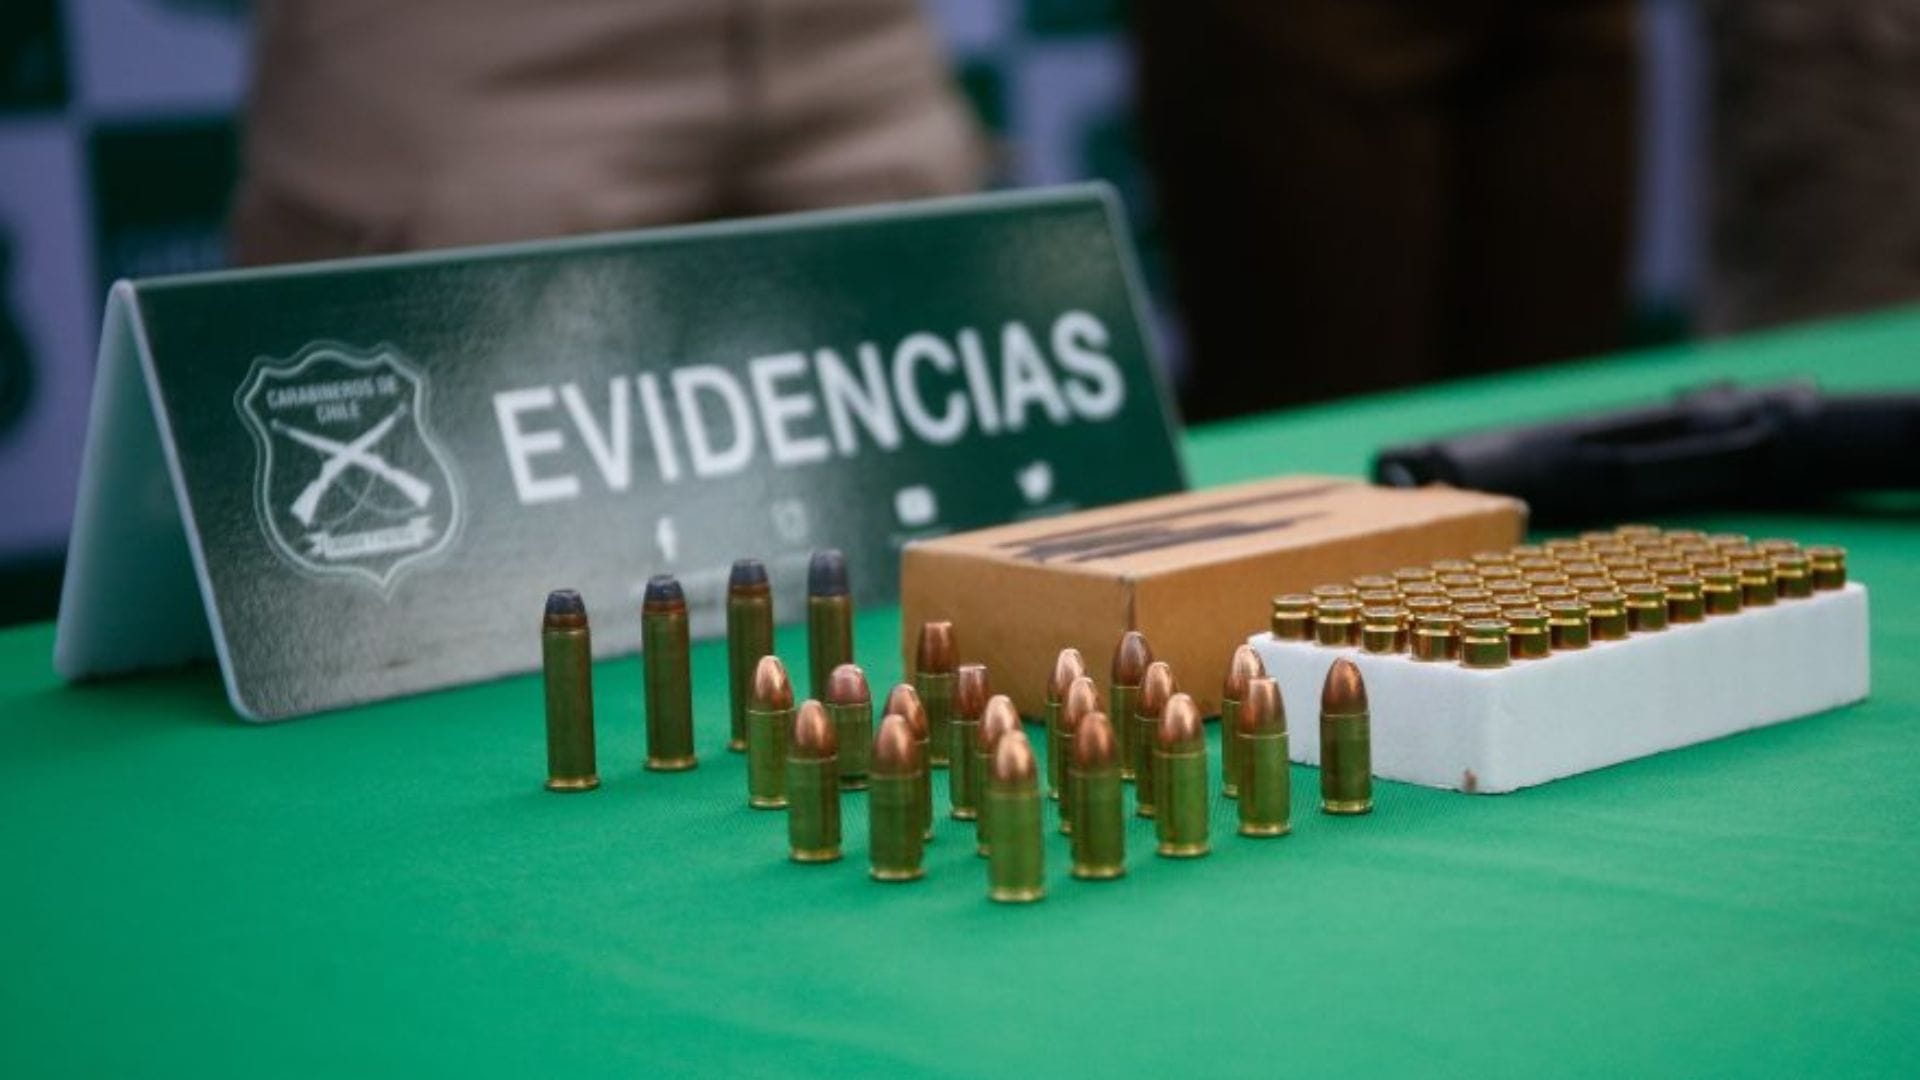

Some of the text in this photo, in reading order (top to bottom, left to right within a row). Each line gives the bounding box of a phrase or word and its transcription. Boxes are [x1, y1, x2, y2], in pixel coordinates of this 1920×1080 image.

[266, 374, 397, 409] CARABINEROS DE
[493, 310, 1125, 505] EVIDENCIAS
[315, 401, 360, 425] CHILE
